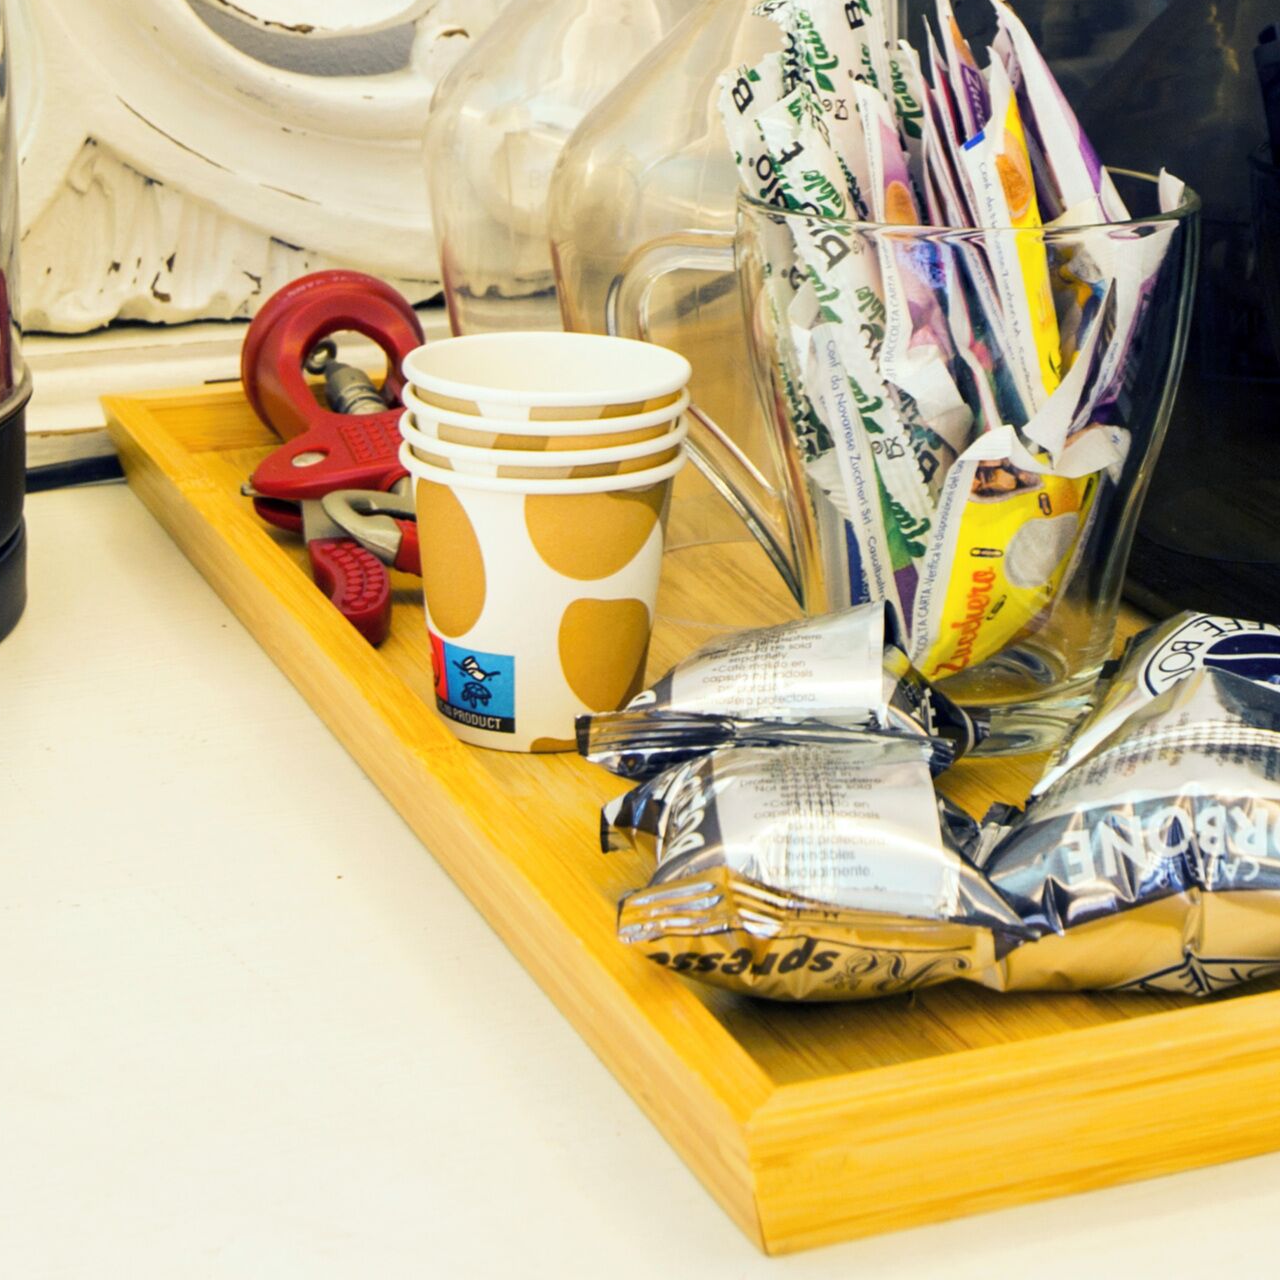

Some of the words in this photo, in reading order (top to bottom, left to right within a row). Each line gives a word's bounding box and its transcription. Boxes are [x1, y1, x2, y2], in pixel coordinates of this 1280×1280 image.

[835, 392, 856, 451] Novarese
[849, 453, 871, 507] Zuccheri
[918, 588, 931, 618] CARTA
[931, 567, 997, 676] Zucchero
[453, 706, 502, 731] PRODUCT
